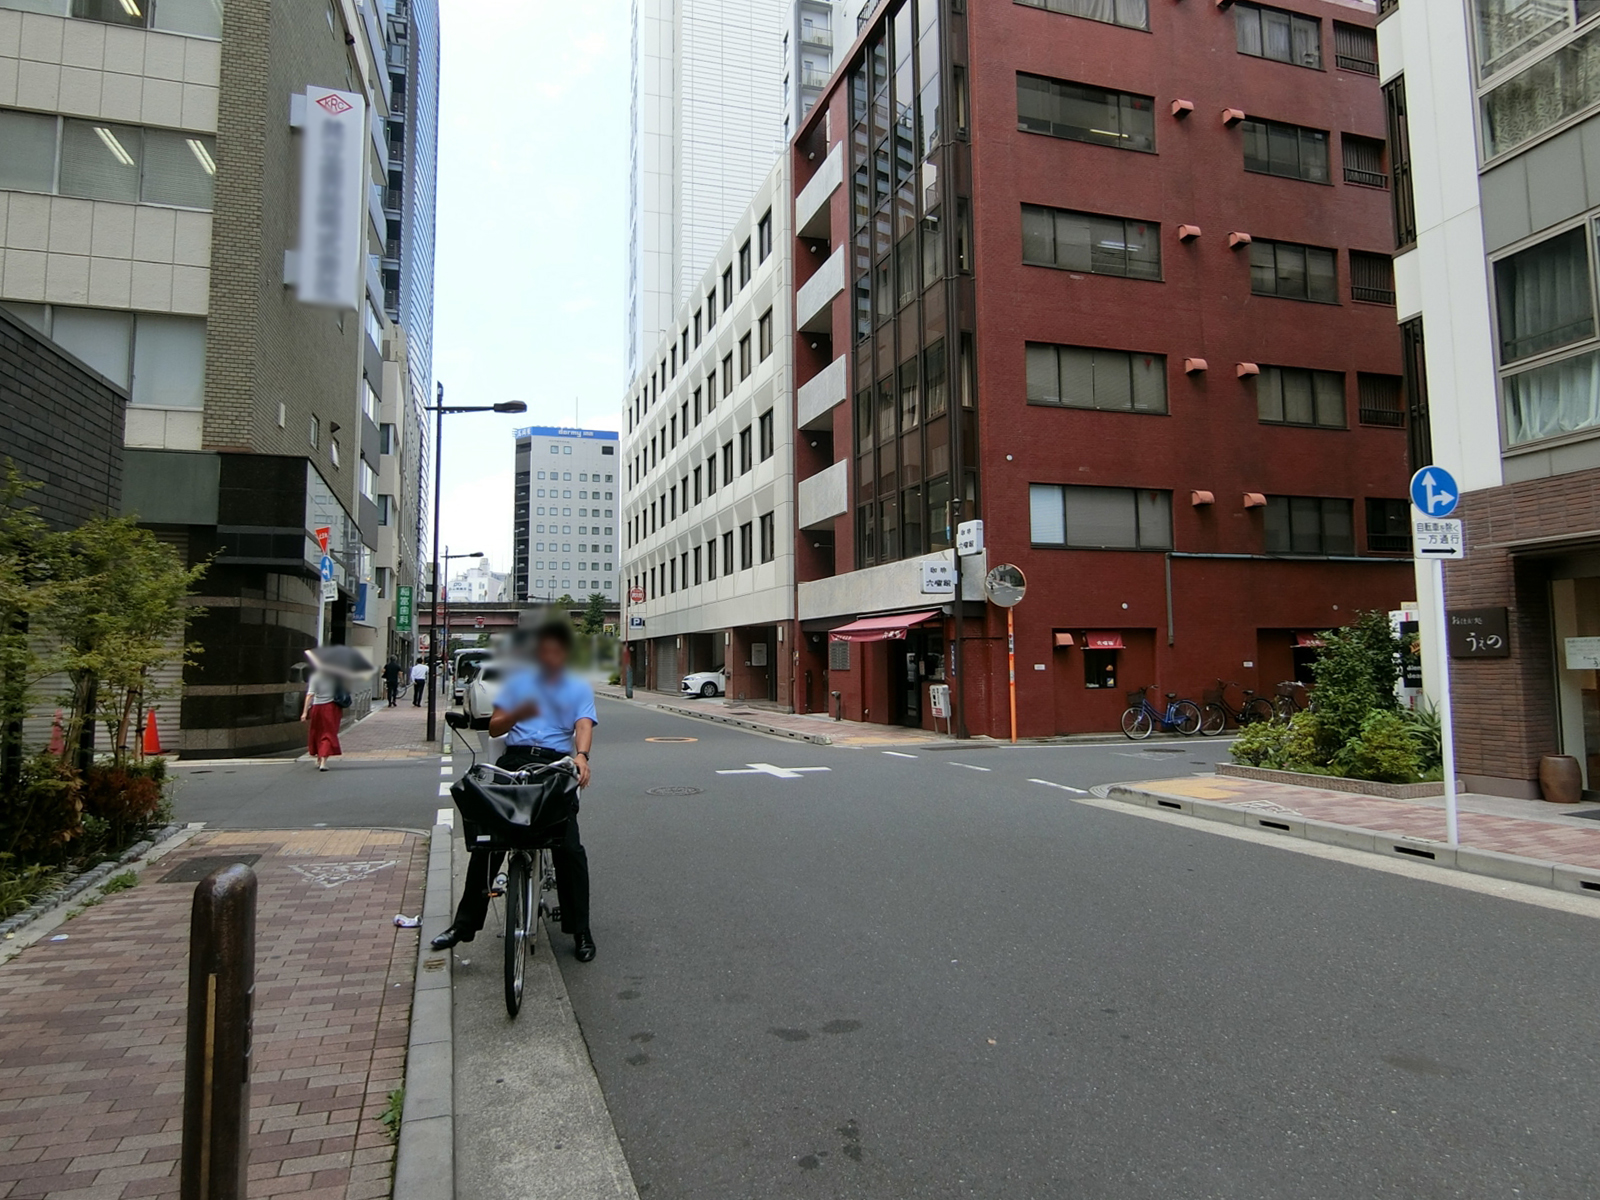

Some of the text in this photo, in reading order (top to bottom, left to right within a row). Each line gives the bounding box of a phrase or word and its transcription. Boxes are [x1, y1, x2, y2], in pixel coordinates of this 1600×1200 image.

[324, 98, 345, 111] KRC
[1417, 534, 1459, 545] 一方通行
